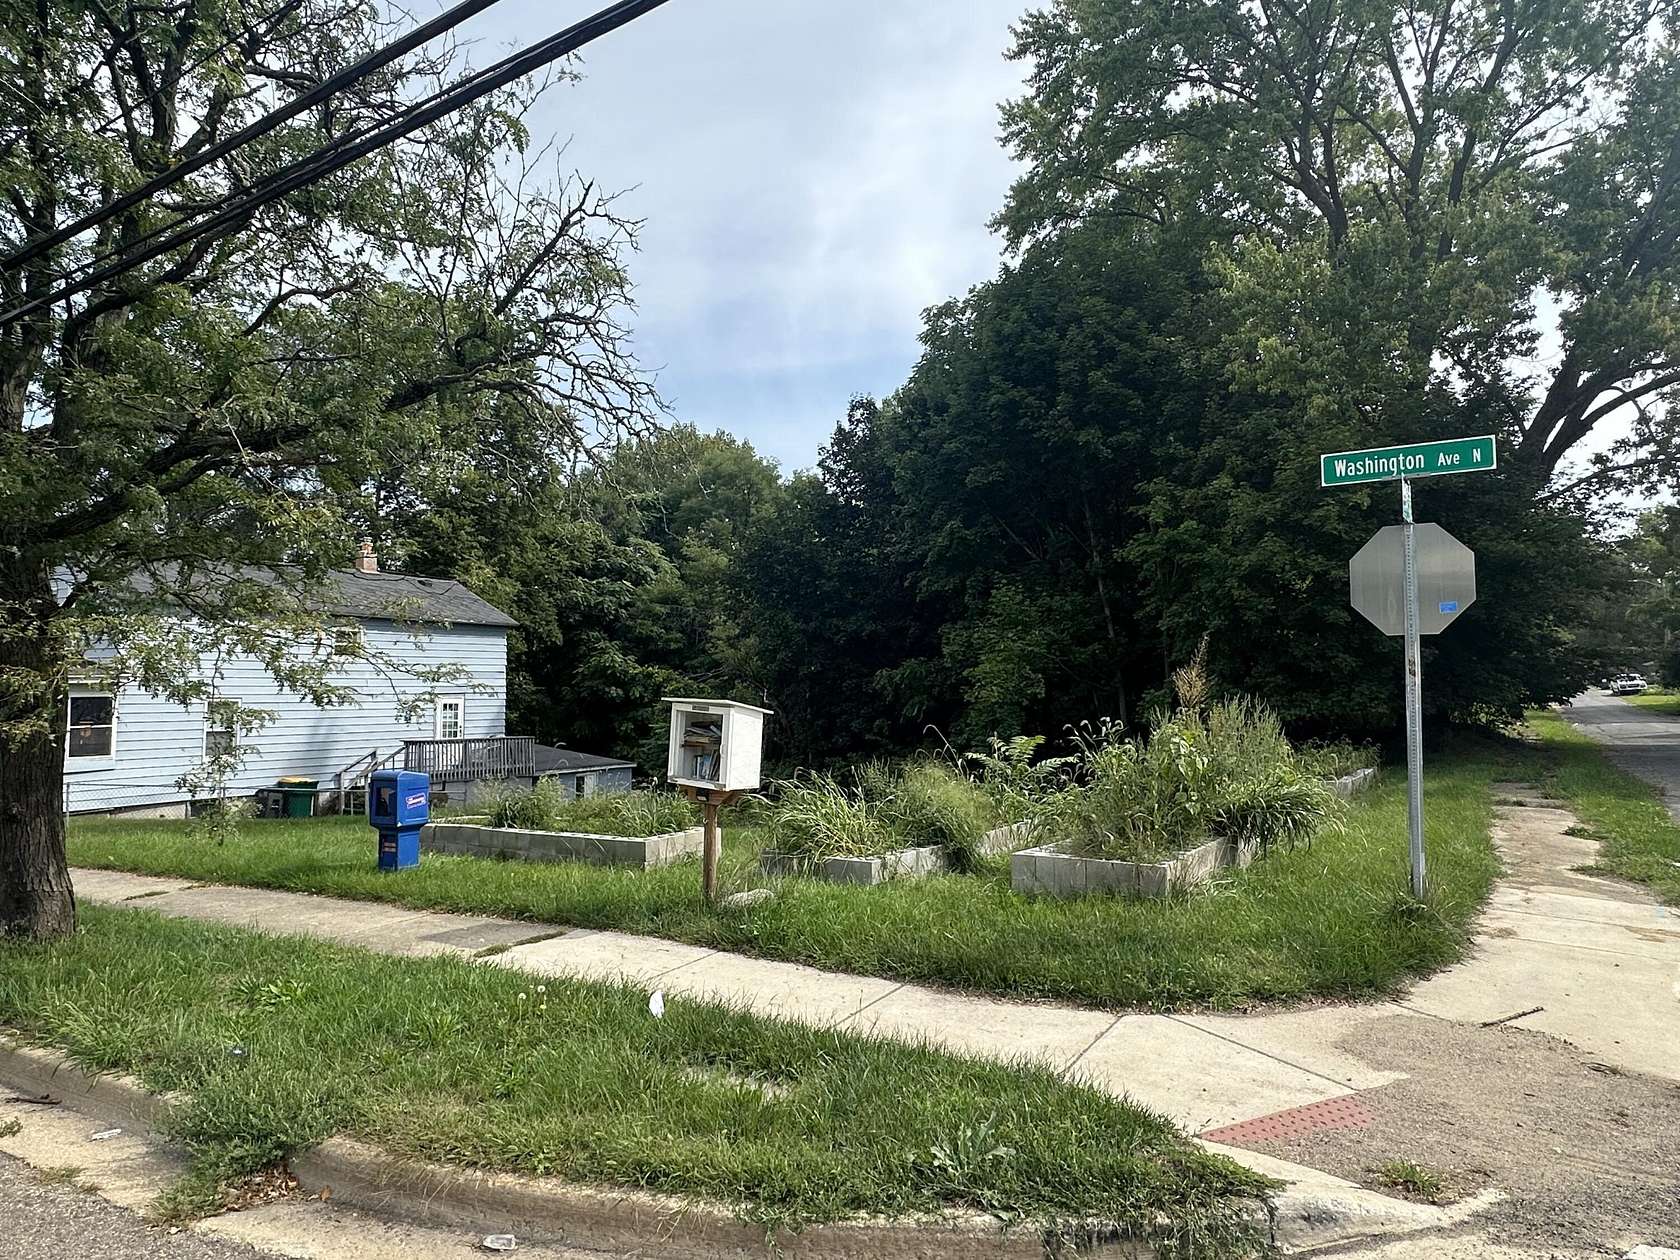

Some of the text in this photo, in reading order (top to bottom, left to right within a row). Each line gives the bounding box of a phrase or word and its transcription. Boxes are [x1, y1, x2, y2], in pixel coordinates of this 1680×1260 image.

[1334, 448, 1481, 477] Washington Ave N
